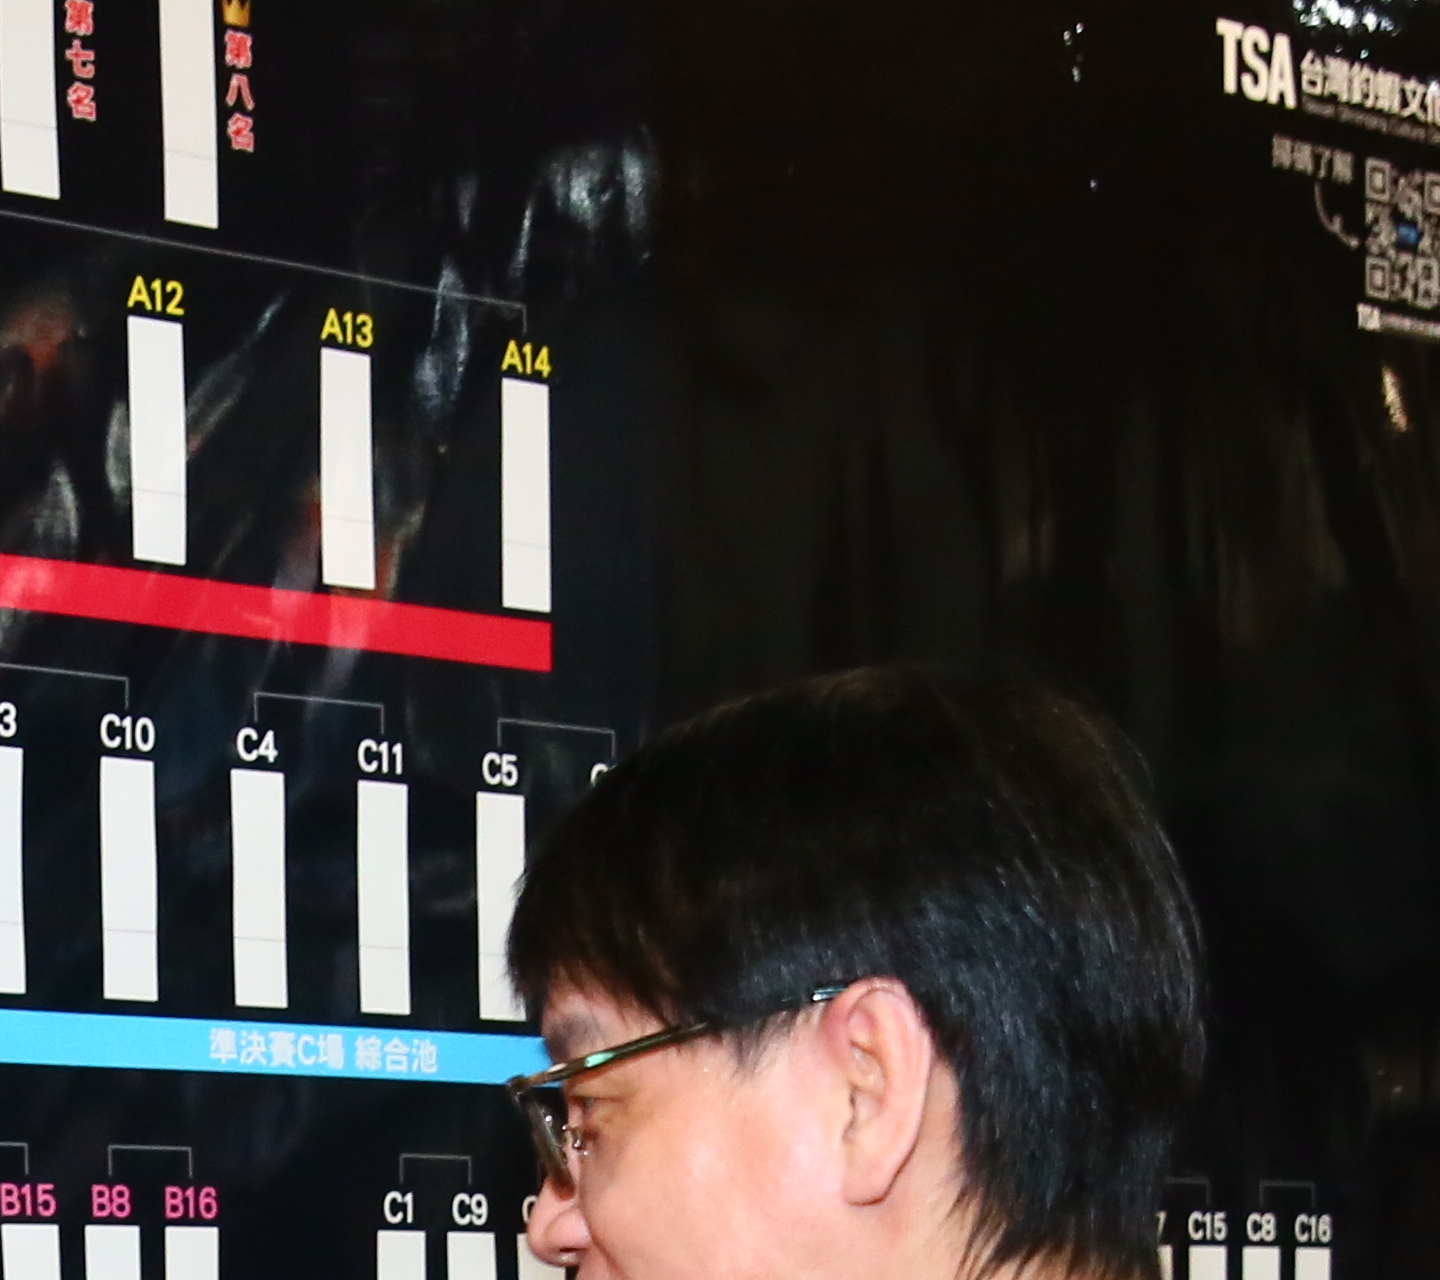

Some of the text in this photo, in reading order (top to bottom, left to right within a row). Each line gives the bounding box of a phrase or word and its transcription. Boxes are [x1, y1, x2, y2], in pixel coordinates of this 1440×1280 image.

[64, 0, 97, 121] 第七名
[223, 30, 255, 153] 第八名
[1215, 17, 1297, 110] TSA
[127, 275, 185, 316] A12
[321, 308, 373, 348] A13
[501, 341, 551, 378] A14
[100, 713, 155, 752] C10
[236, 727, 278, 763] C4
[357, 738, 402, 775] C11
[482, 752, 518, 787] C5
[0, 1182, 57, 1217] B15
[91, 1184, 131, 1218] B8
[164, 1185, 218, 1220] B16
[383, 1191, 413, 1224] C1
[452, 1193, 488, 1226] C9
[1188, 1210, 1227, 1241] C15
[1246, 1212, 1276, 1242] C8
[1294, 1213, 1331, 1243] C16
